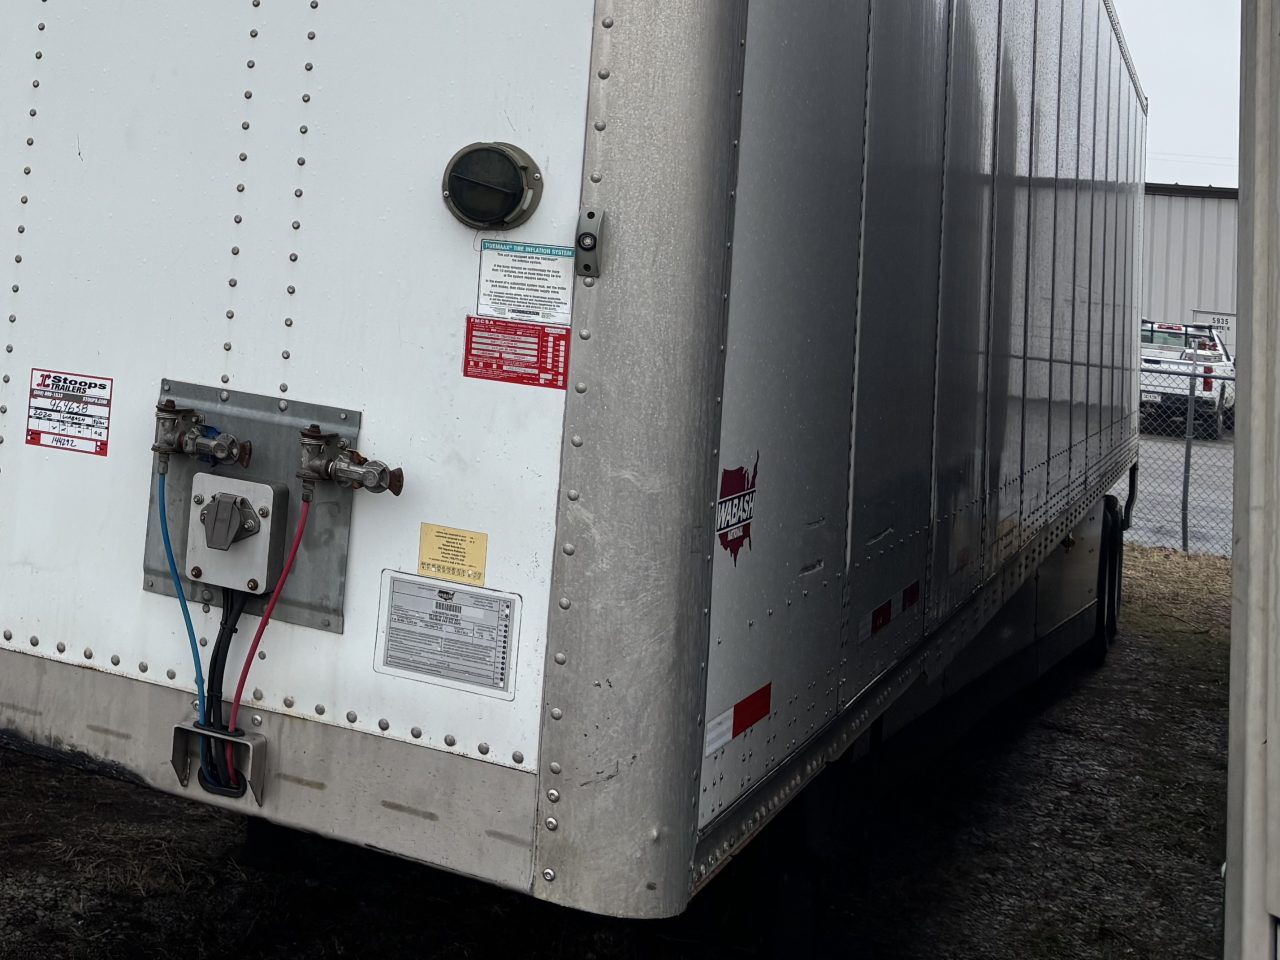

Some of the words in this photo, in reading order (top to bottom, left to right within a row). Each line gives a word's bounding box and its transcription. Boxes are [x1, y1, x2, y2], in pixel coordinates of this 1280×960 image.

[50, 383, 87, 394] TRAILERS
[51, 375, 108, 390] Stoops
[717, 491, 756, 530] WABASH
